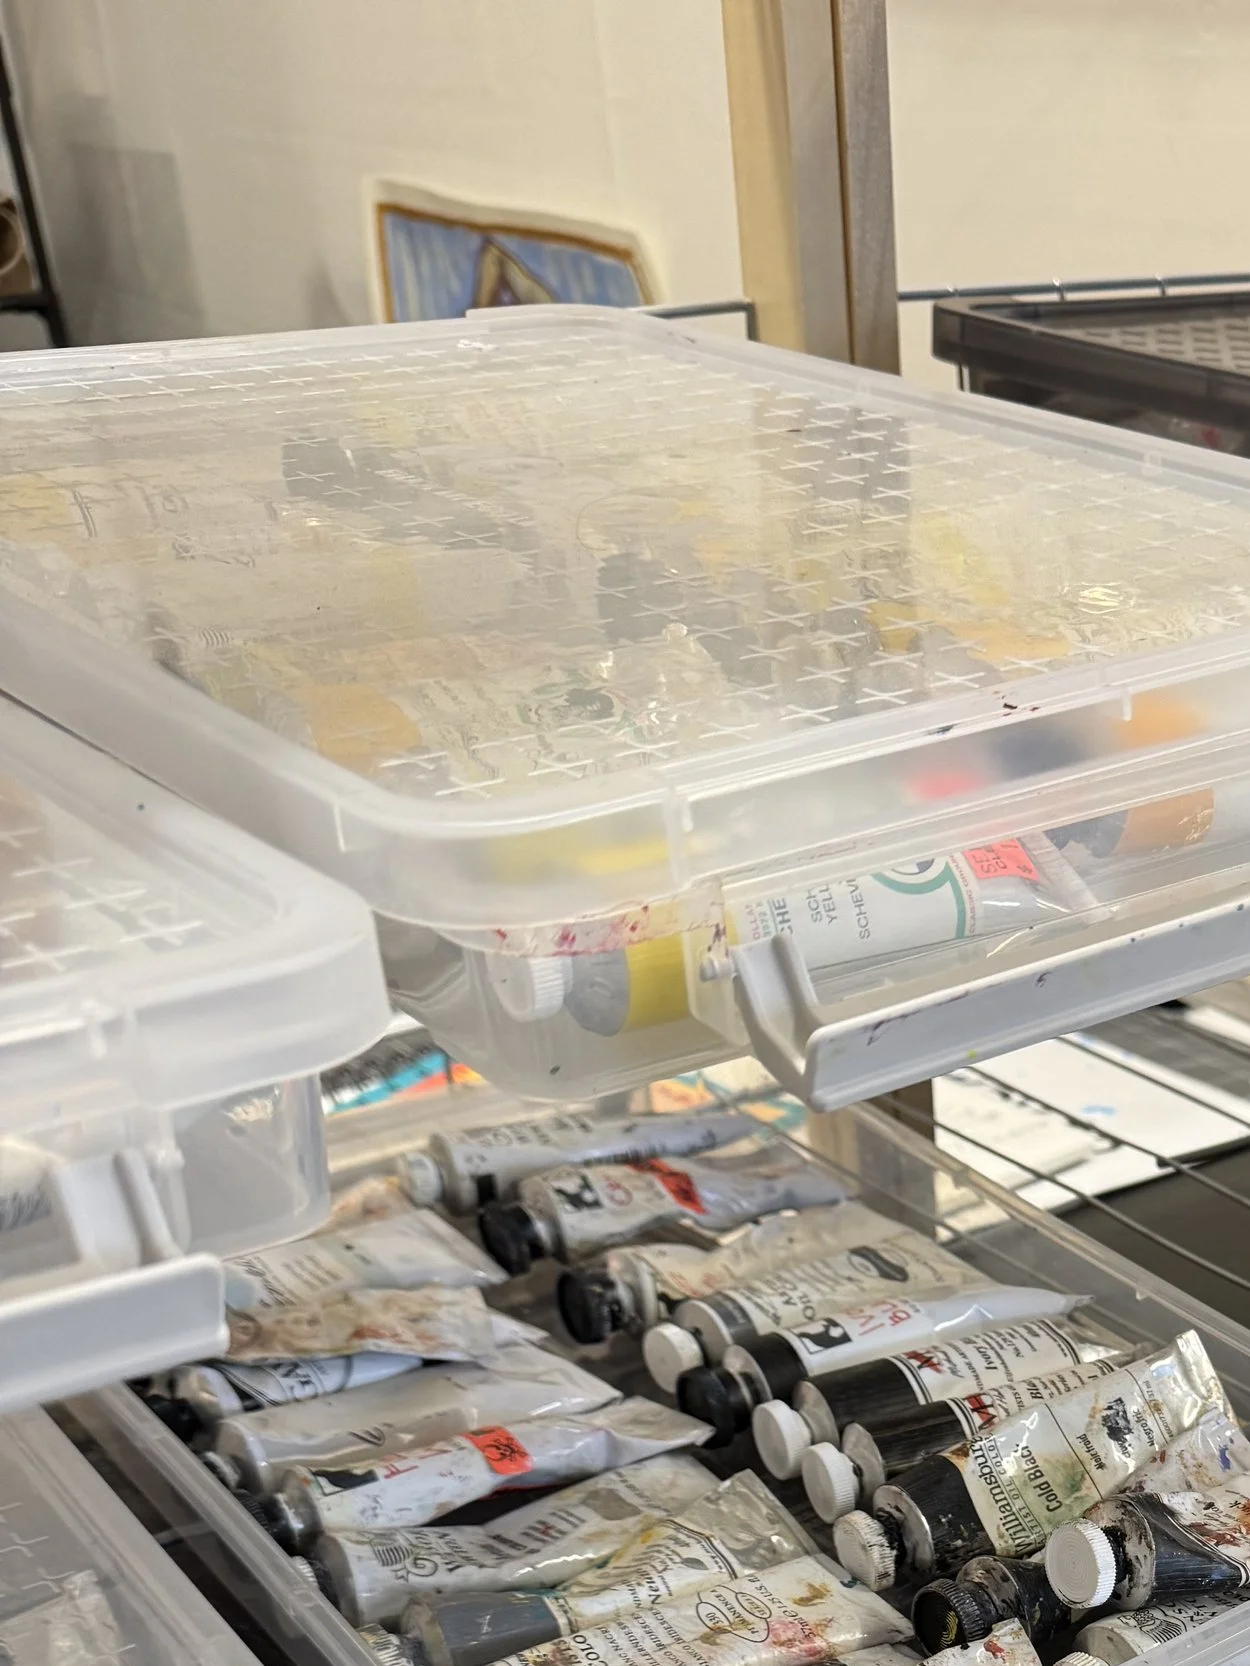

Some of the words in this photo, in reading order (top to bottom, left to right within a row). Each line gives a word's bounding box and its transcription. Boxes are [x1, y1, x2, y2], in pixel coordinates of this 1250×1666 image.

[1075, 1432, 1095, 1457] froid
[970, 1433, 1032, 1553] Williamsburg
[1006, 1480, 1019, 1501] OIL
[1033, 1479, 1063, 1513] Cold
[705, 1611, 724, 1626] 330
